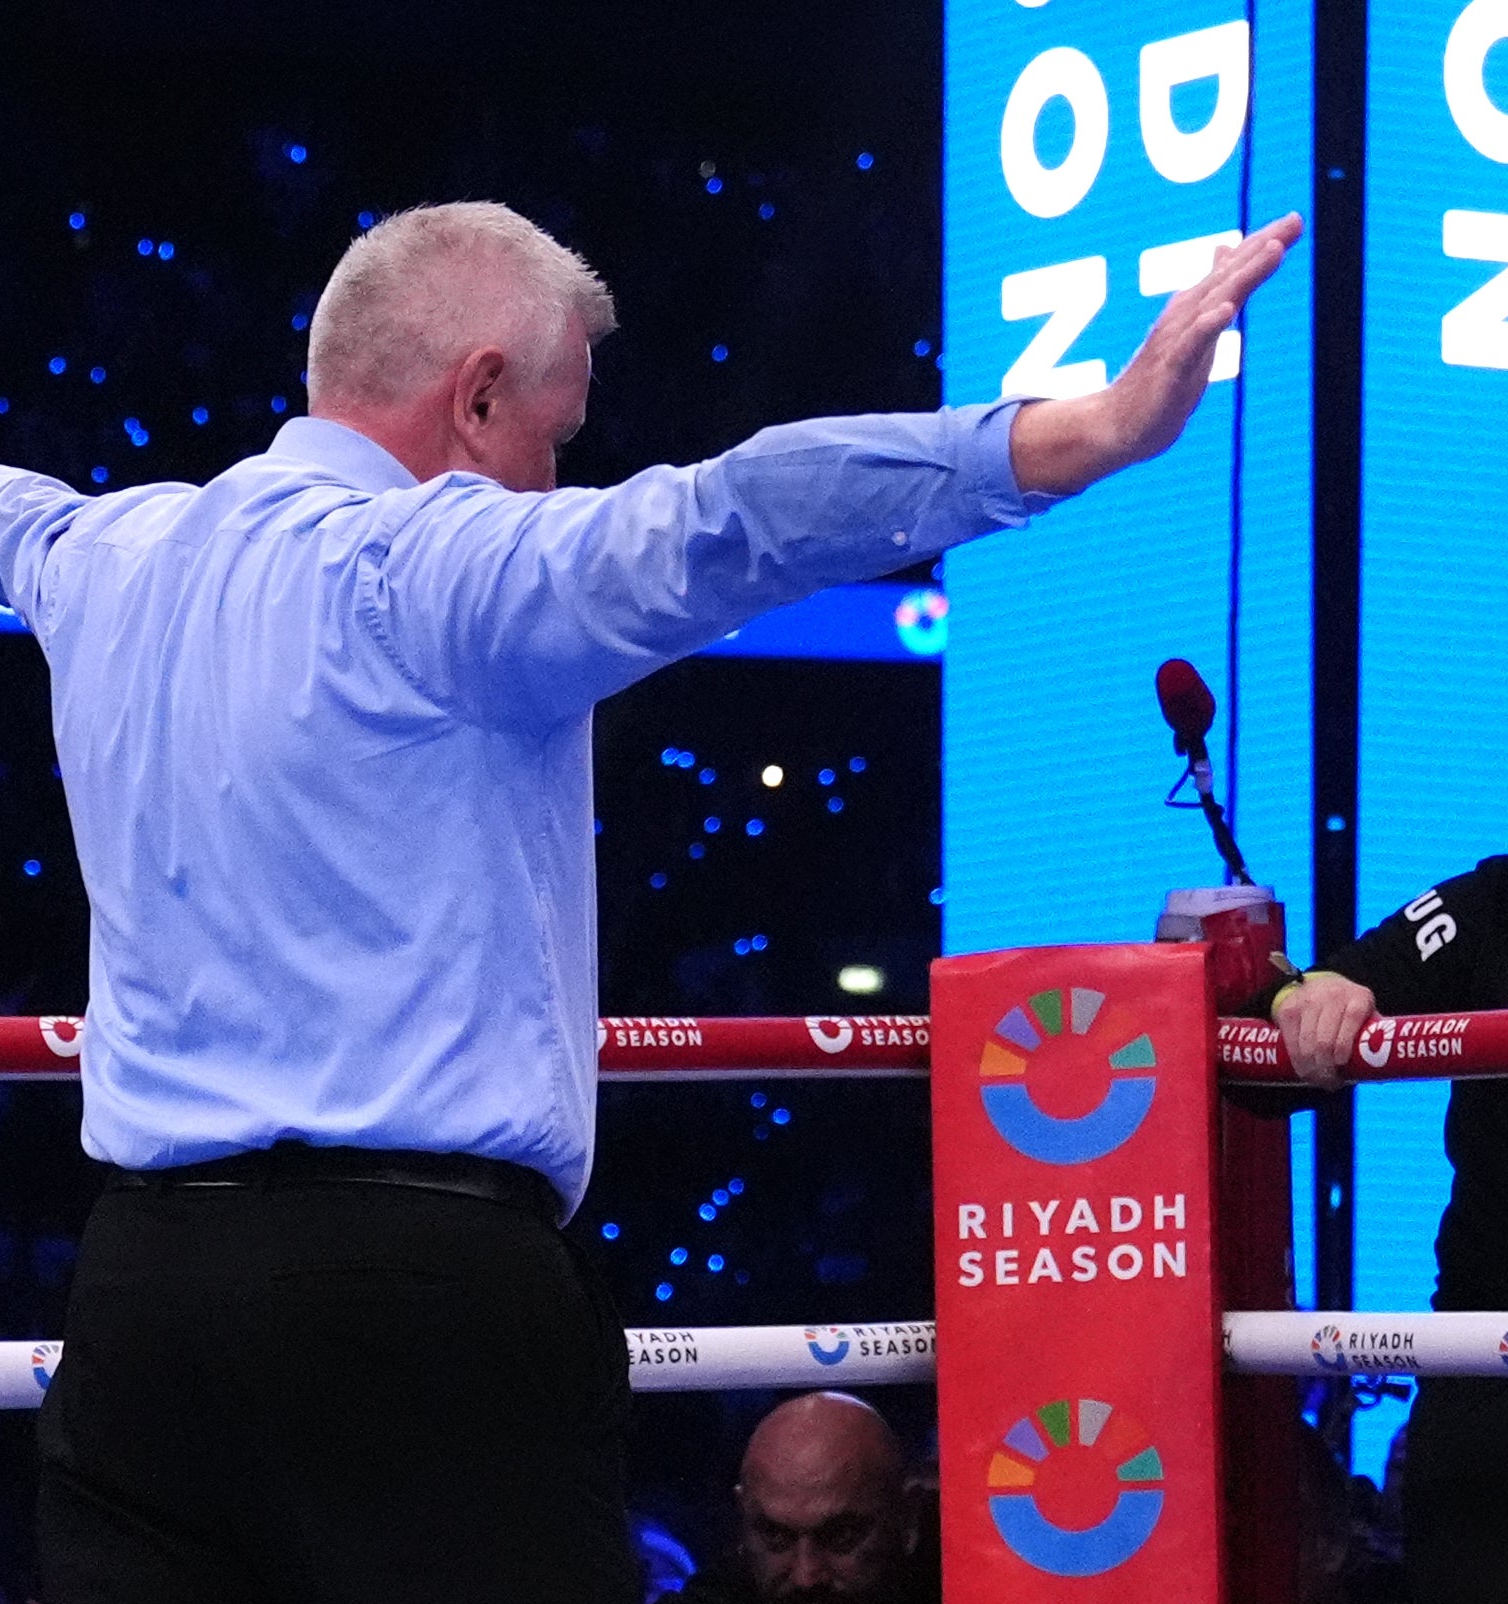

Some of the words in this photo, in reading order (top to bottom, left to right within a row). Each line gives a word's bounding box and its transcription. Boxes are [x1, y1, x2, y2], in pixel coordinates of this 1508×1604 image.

[860, 1028, 929, 1046] SEASO
[1218, 1023, 1280, 1043] RIYADH
[1399, 1017, 1471, 1037] RIYADH
[615, 1029, 702, 1047] SEASON
[1396, 1037, 1462, 1059] SEASON
[958, 1193, 1186, 1240] RIYADH
[958, 1241, 1186, 1287] SEASON
[859, 1336, 937, 1357] SEASO
[1349, 1332, 1414, 1350] RIYADH
[628, 1347, 698, 1366] EASON
